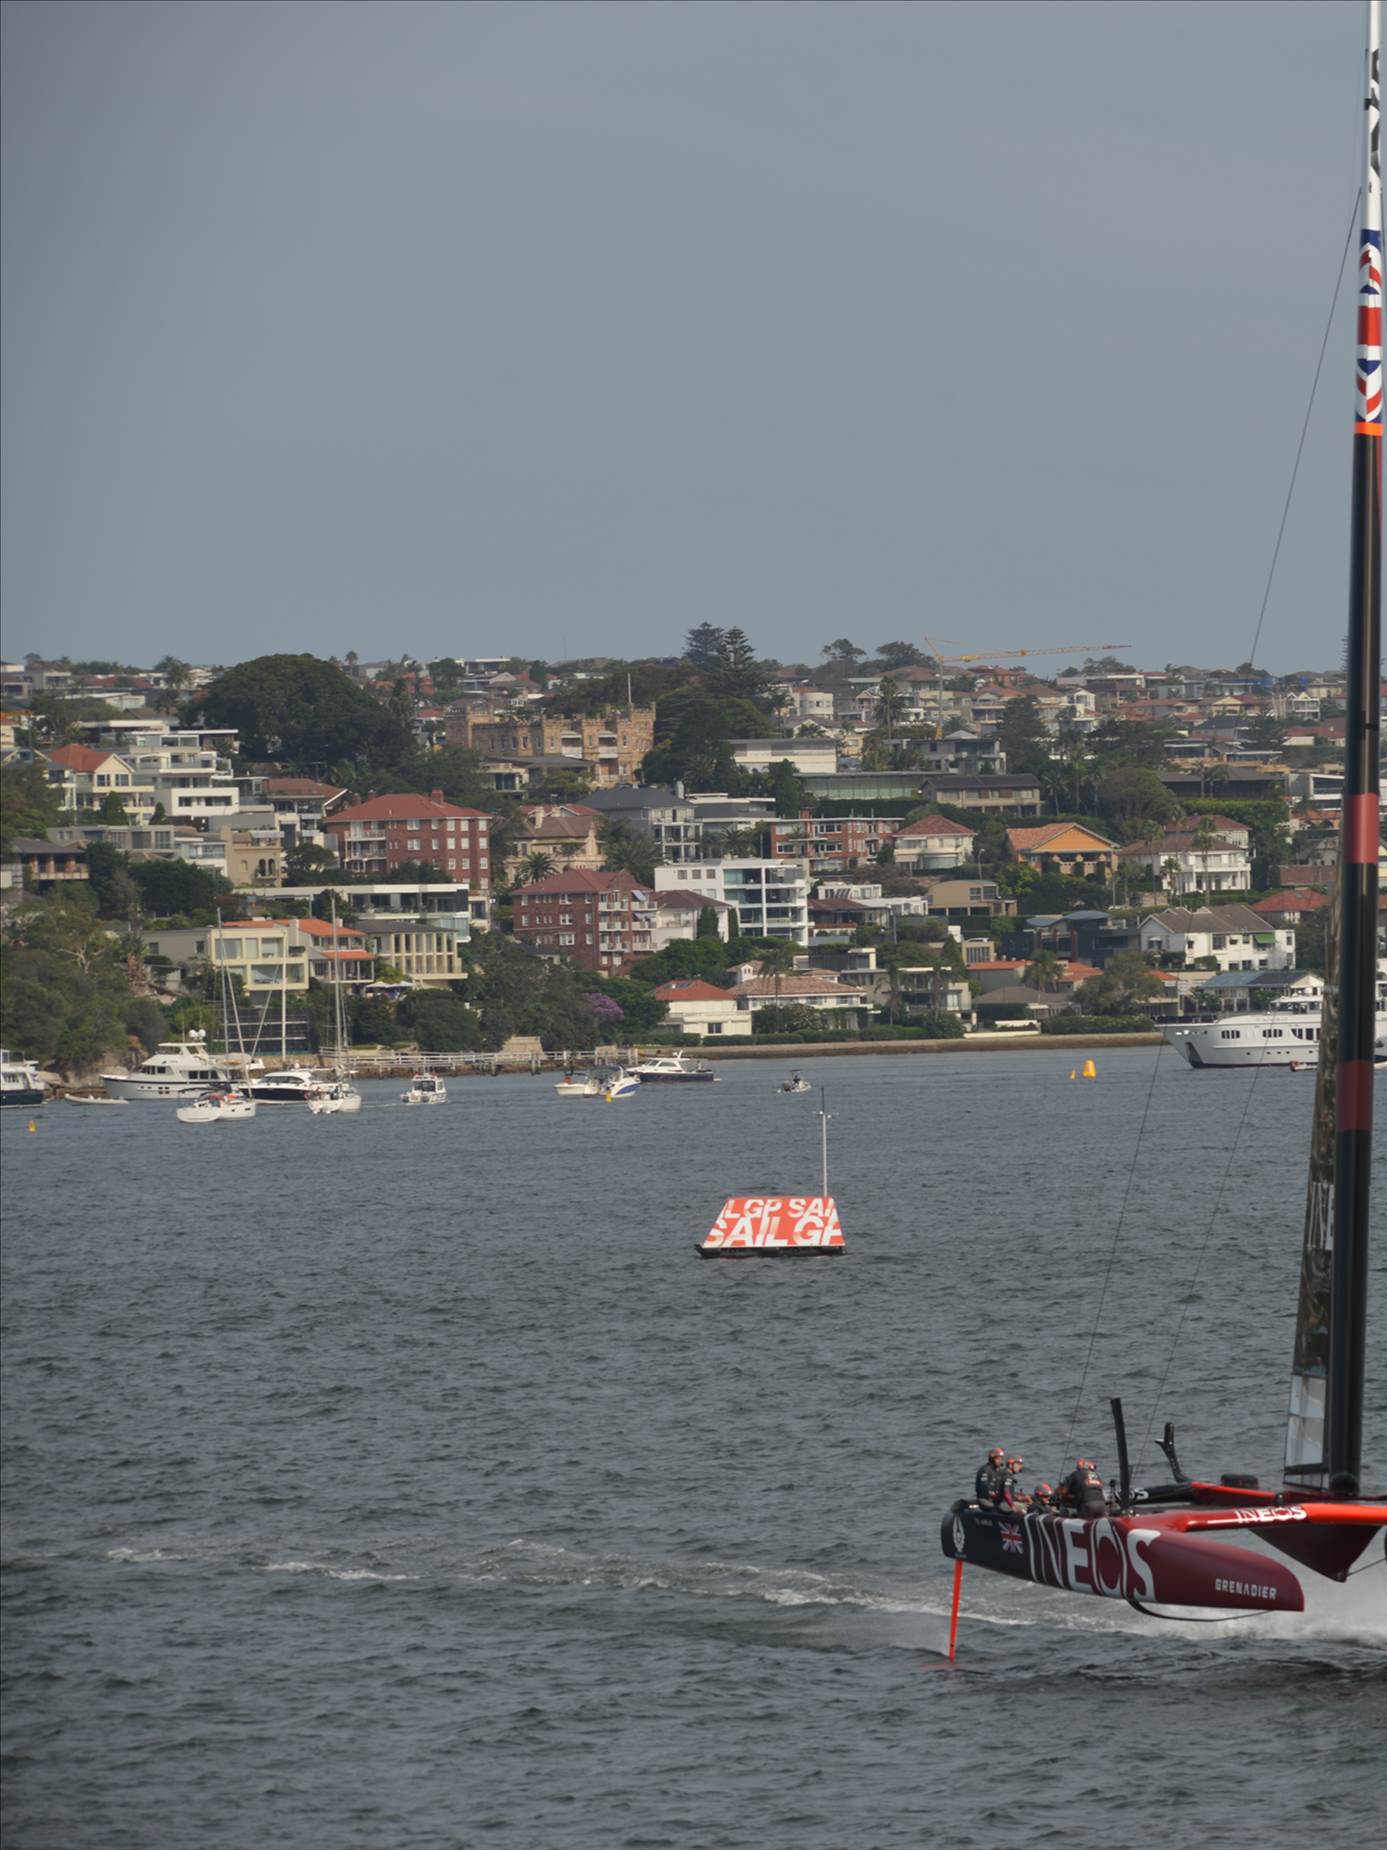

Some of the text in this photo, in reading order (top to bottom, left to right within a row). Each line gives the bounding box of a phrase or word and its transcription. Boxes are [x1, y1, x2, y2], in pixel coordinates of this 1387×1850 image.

[744, 1199, 783, 1218] GP
[703, 1217, 789, 1247] SAIL
[1234, 1505, 1308, 1524] INEOS
[1024, 1513, 1161, 1603] INEOS
[1215, 1578, 1278, 1600] GRENADIER
